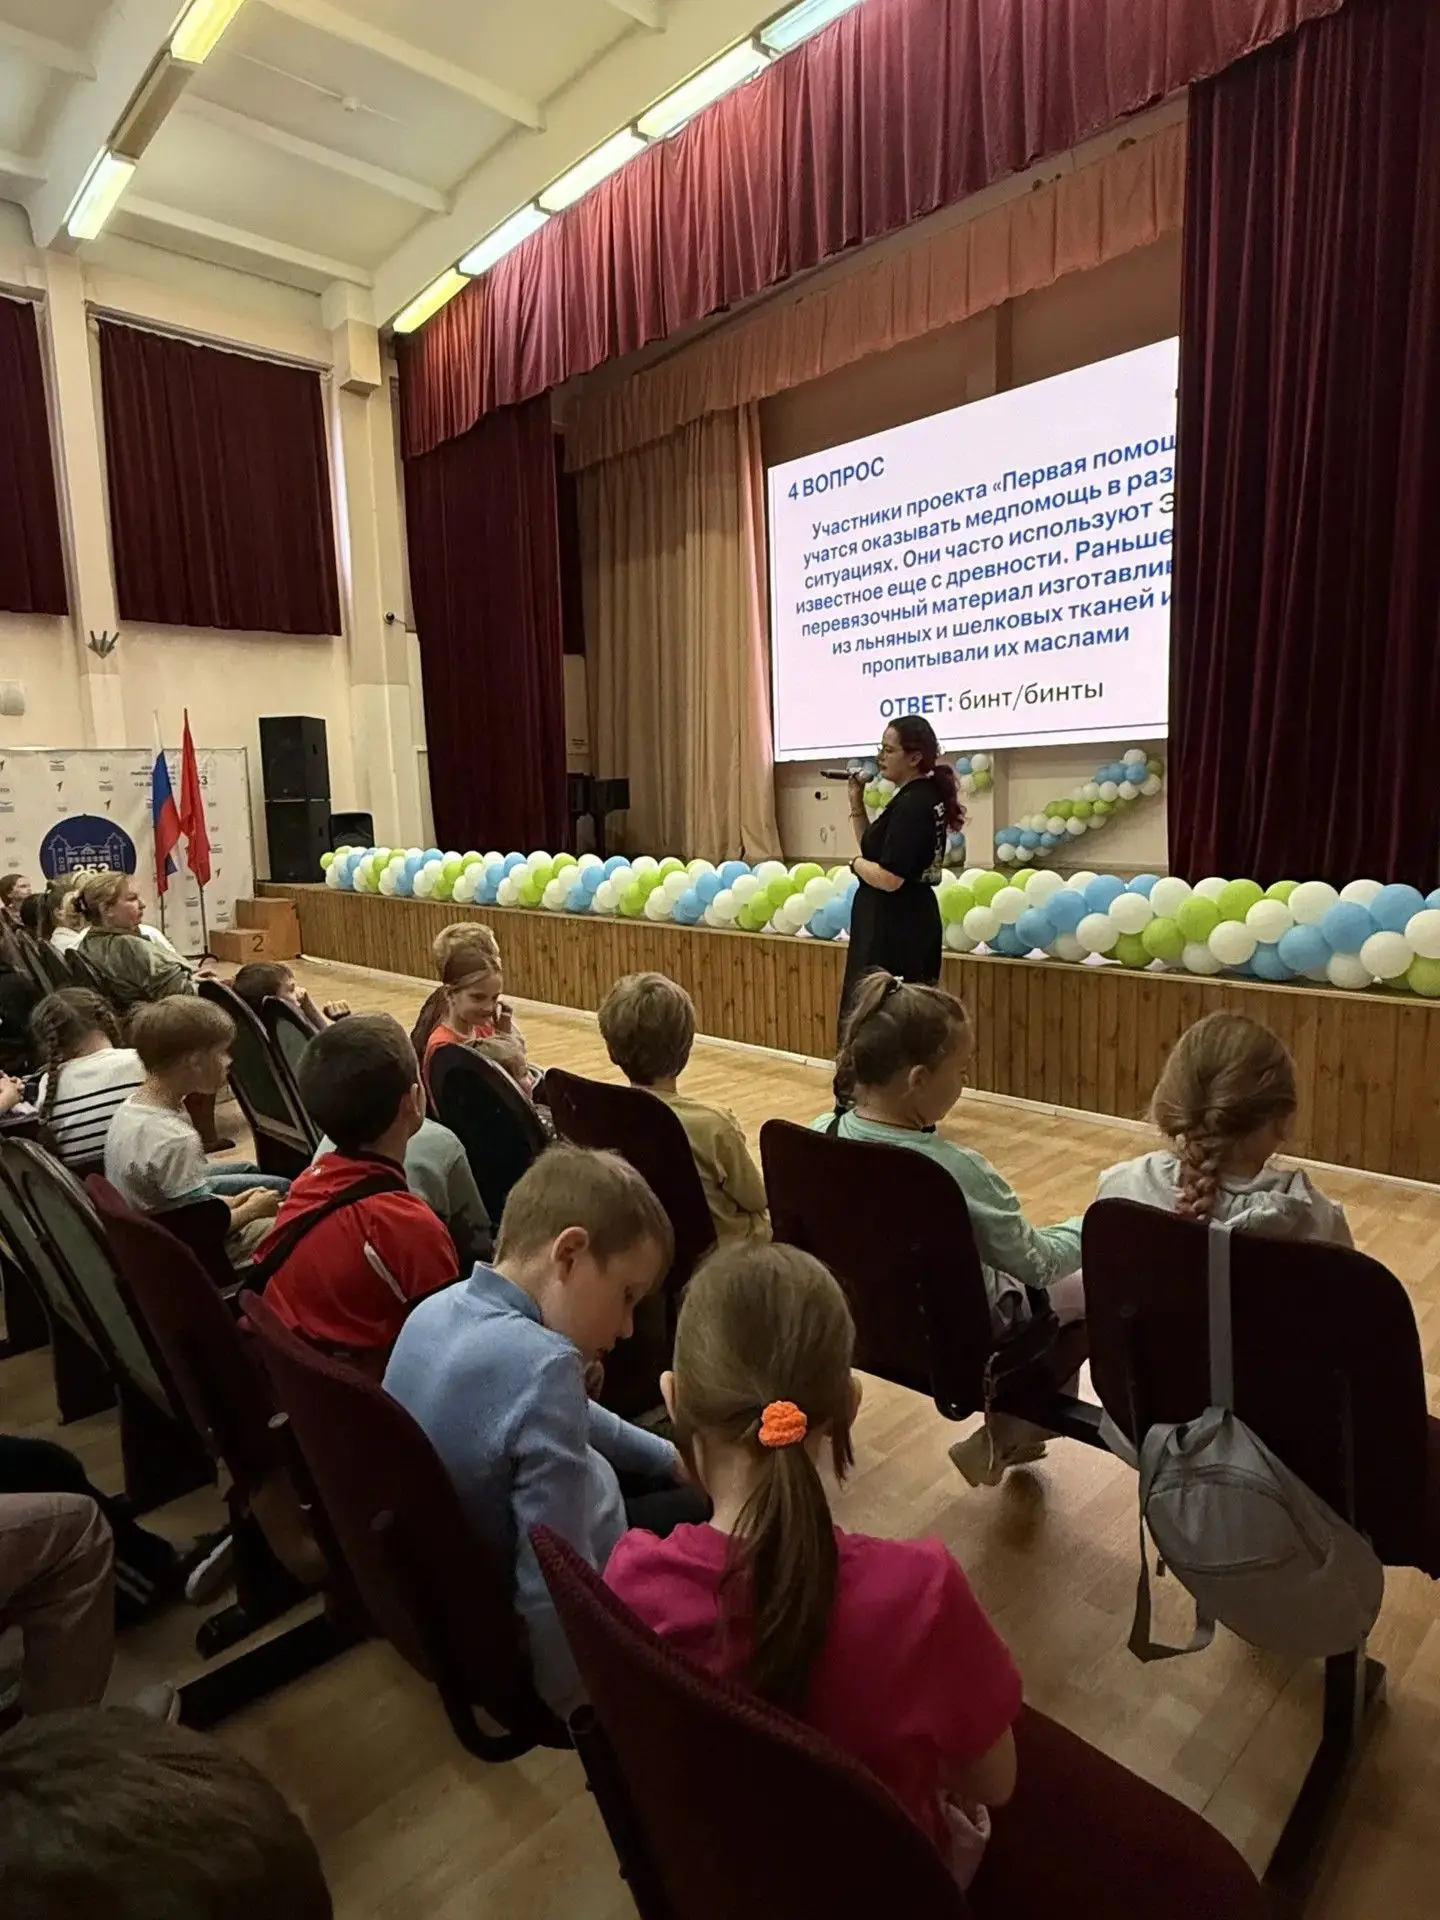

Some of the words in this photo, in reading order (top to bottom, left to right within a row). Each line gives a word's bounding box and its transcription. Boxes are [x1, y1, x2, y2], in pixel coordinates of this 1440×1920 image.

[788, 482, 799, 501] 4
[803, 456, 885, 497] ВОПРОС
[812, 505, 902, 540] Участники
[906, 483, 987, 517] проекта
[993, 457, 1087, 492] «Первая
[803, 541, 857, 570] учатся
[861, 518, 961, 552] оказывать
[965, 485, 1102, 528] медпомощь
[1108, 479, 1121, 496] в
[804, 558, 899, 589] ситуациях.
[903, 547, 941, 569] Они
[945, 534, 1004, 560] часто
[1009, 502, 1153, 547] используют
[795, 586, 883, 615] известное
[887, 577, 927, 597] еще
[931, 574, 942, 589] с
[946, 550, 1069, 590] древности.
[1076, 528, 1174, 562] Раньше
[802, 600, 928, 637] перевязочный
[932, 584, 1033, 614] материал
[832, 640, 852, 656] из
[855, 628, 932, 653] льняных
[936, 625, 948, 641] и
[952, 607, 1063, 639] шелковых
[1068, 587, 1154, 620] тканей
[862, 644, 989, 678] пропитывали
[994, 640, 1019, 658] их
[1024, 626, 1130, 655] маслами
[880, 693, 953, 718] ОТВЕТ:
[959, 682, 1103, 712] бинт/бинты
[252, 935, 264, 952] 2
